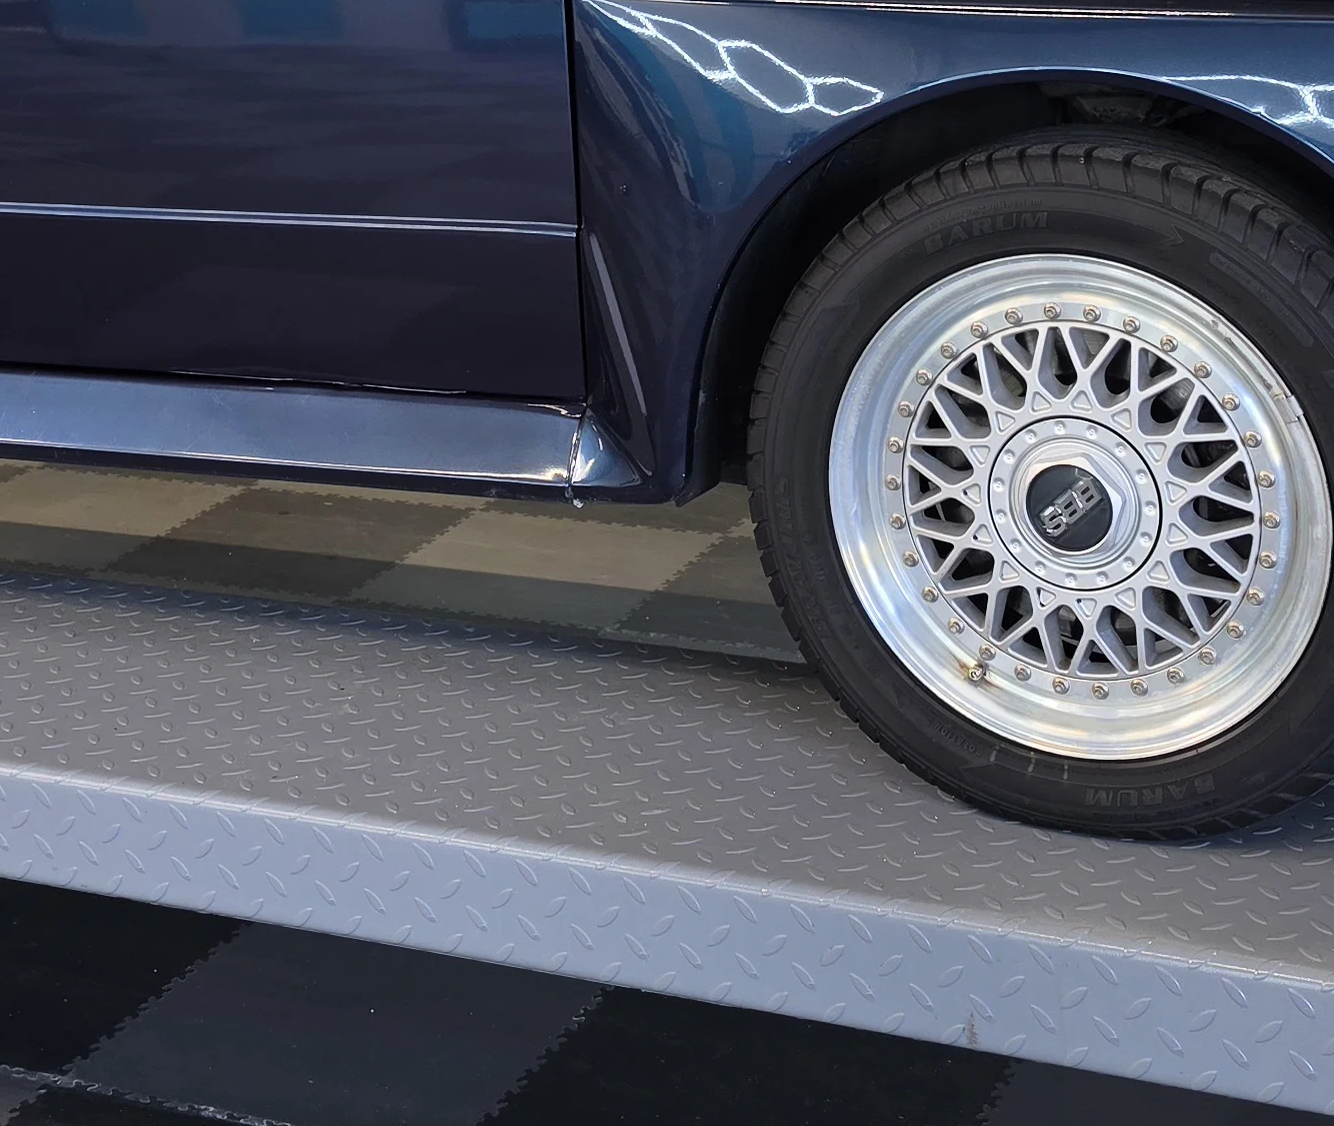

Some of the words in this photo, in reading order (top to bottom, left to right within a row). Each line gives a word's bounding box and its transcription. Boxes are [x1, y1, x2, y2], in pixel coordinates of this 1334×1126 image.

[923, 210, 1050, 255] BARUM
[1038, 479, 1103, 538] BBS
[1083, 773, 1217, 809] BARUM
